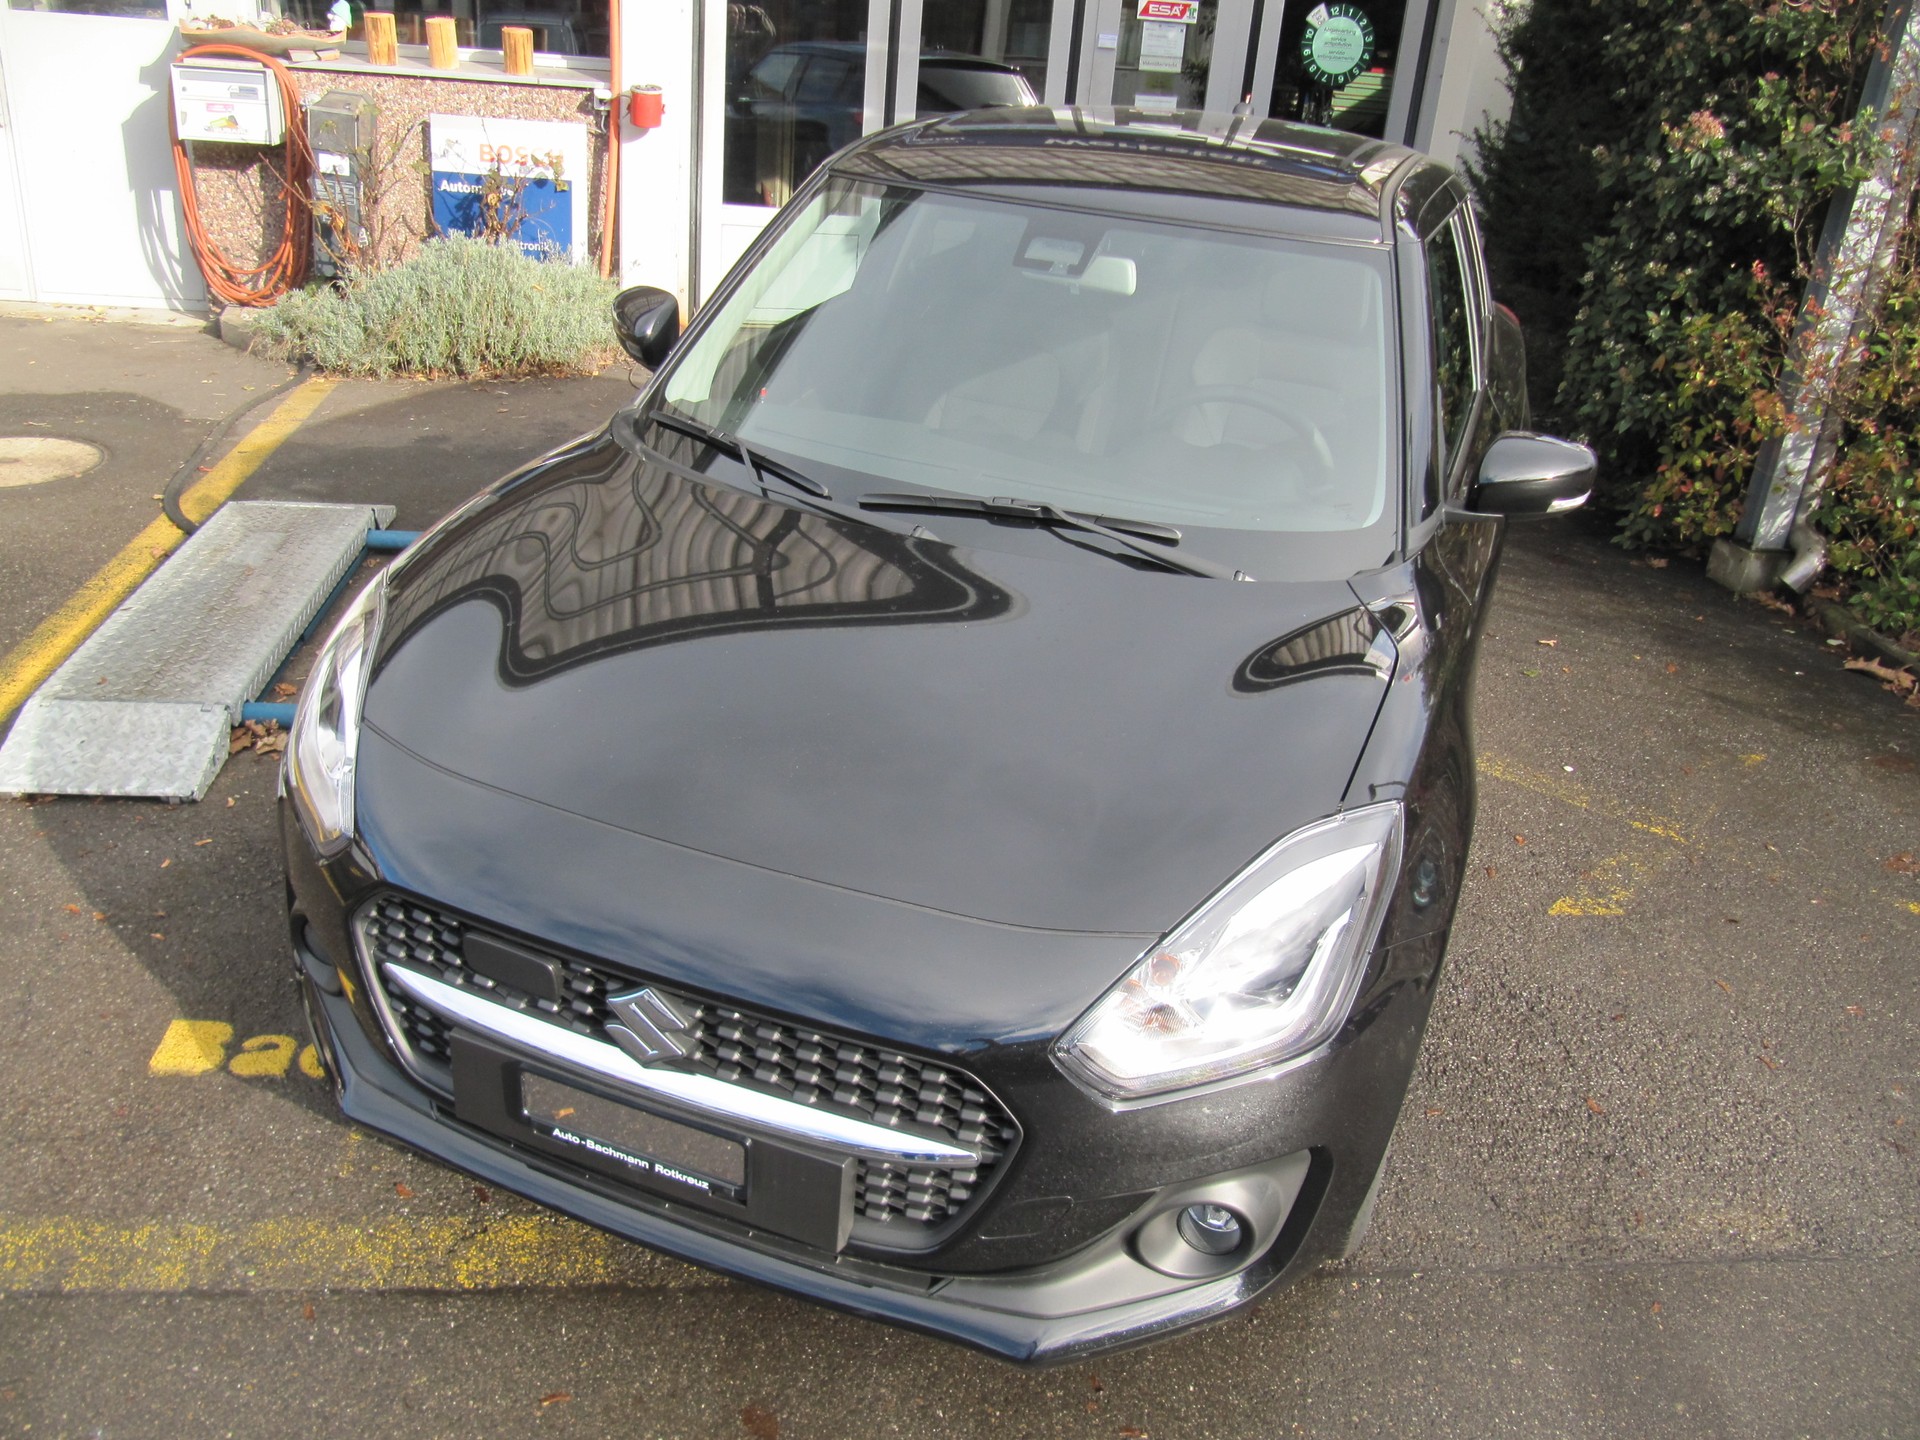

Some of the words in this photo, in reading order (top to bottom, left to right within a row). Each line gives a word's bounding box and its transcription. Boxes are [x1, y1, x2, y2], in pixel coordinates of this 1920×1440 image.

[1330, 6, 1340, 16] 12
[1348, 8, 1354, 17] 1
[1359, 19, 1367, 27] 2
[440, 179, 515, 196] Automve
[654, 1163, 710, 1190] Rotkreuz
